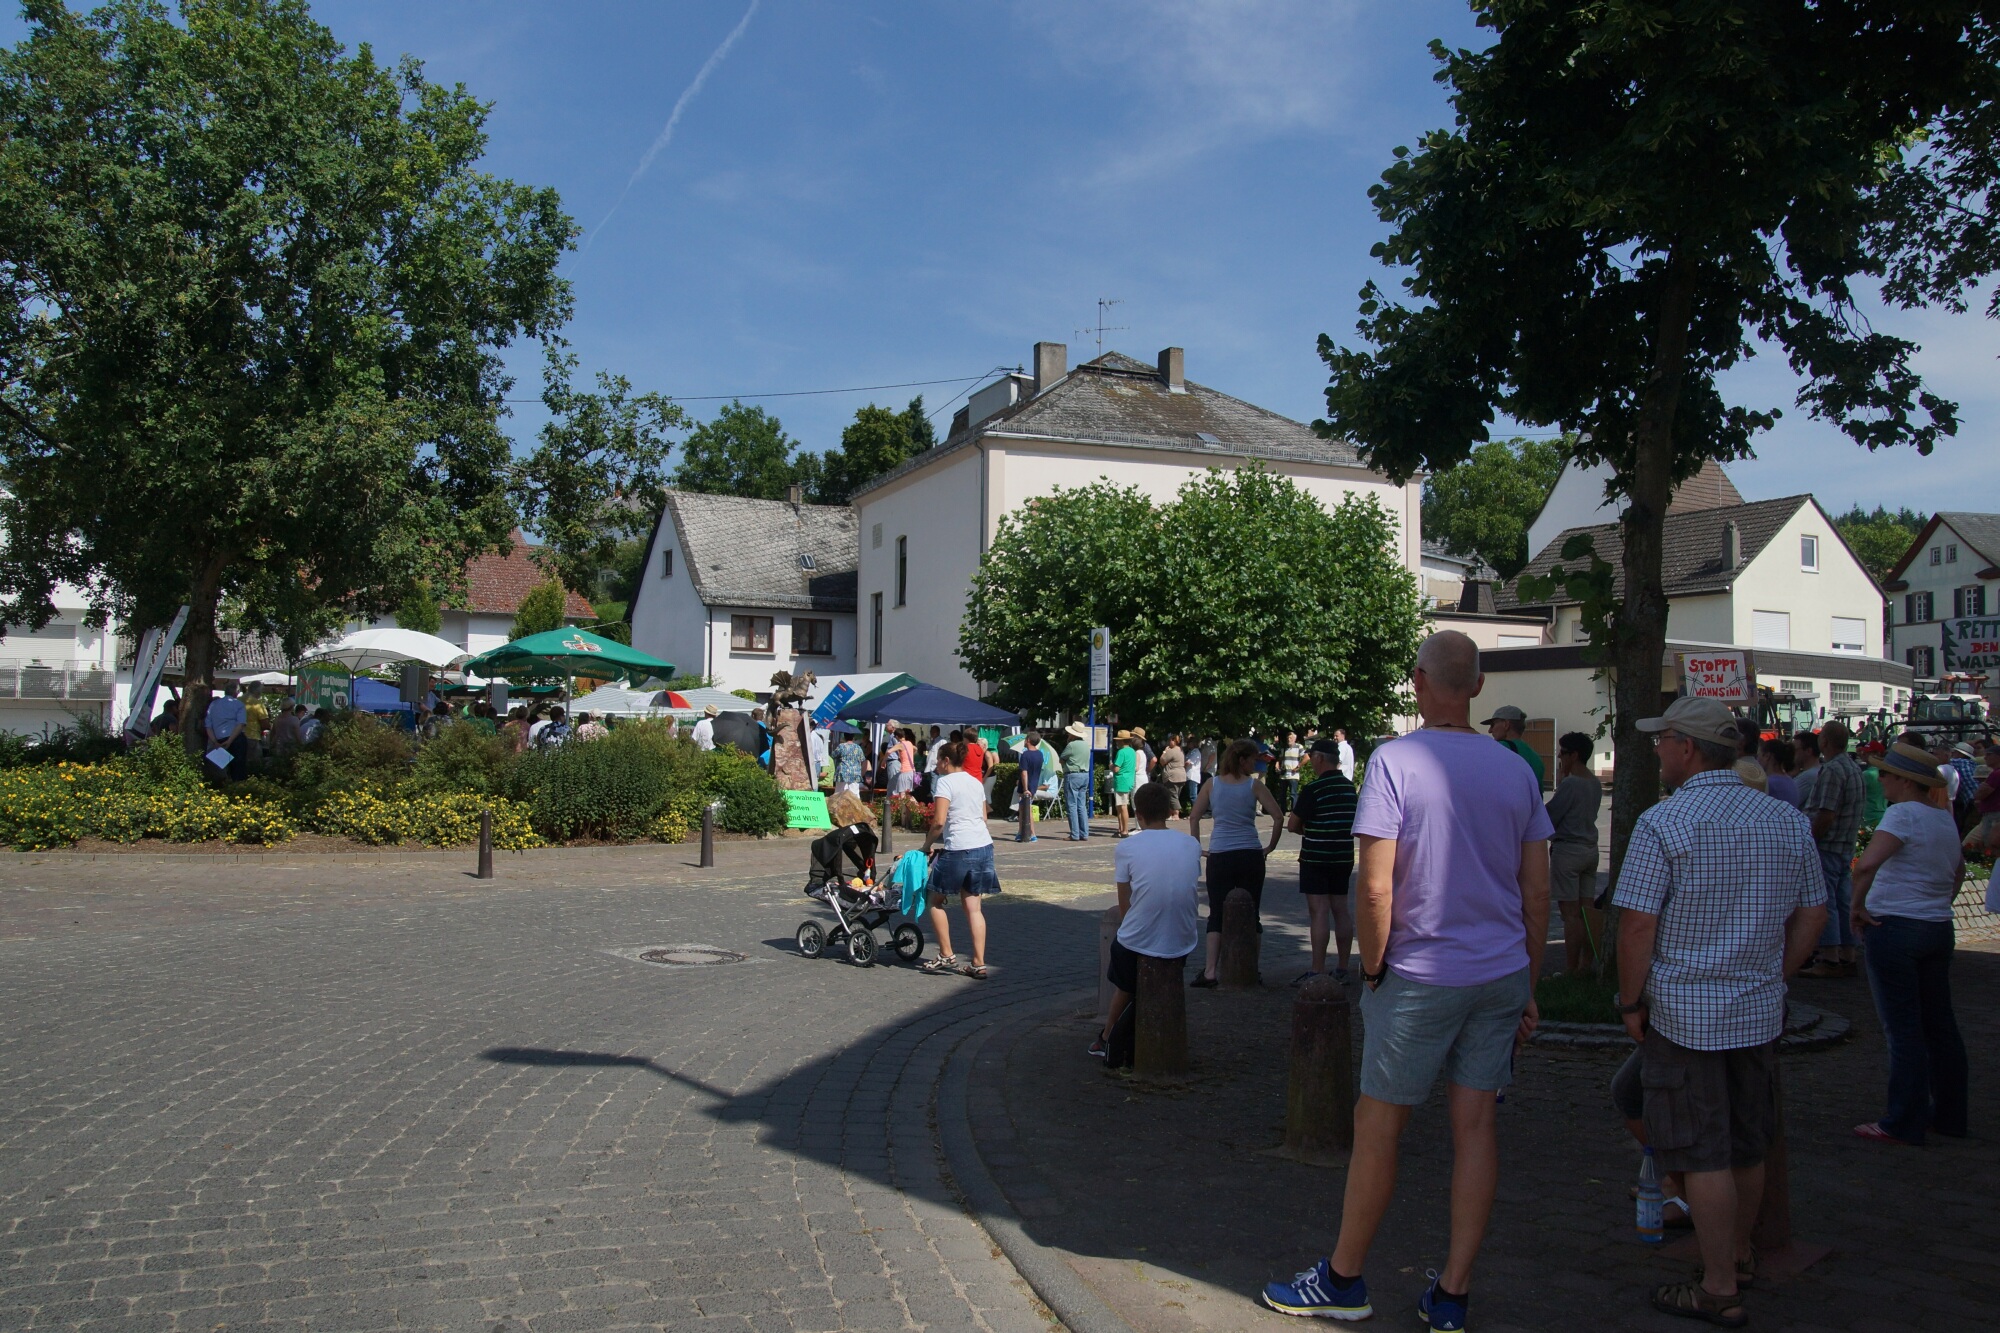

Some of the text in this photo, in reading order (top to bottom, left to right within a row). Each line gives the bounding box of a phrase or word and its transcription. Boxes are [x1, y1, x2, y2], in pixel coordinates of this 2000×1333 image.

[1970, 642, 1999, 653] DEN
[1688, 658, 1737, 673] STOPPT
[1703, 674, 1724, 683] DEN
